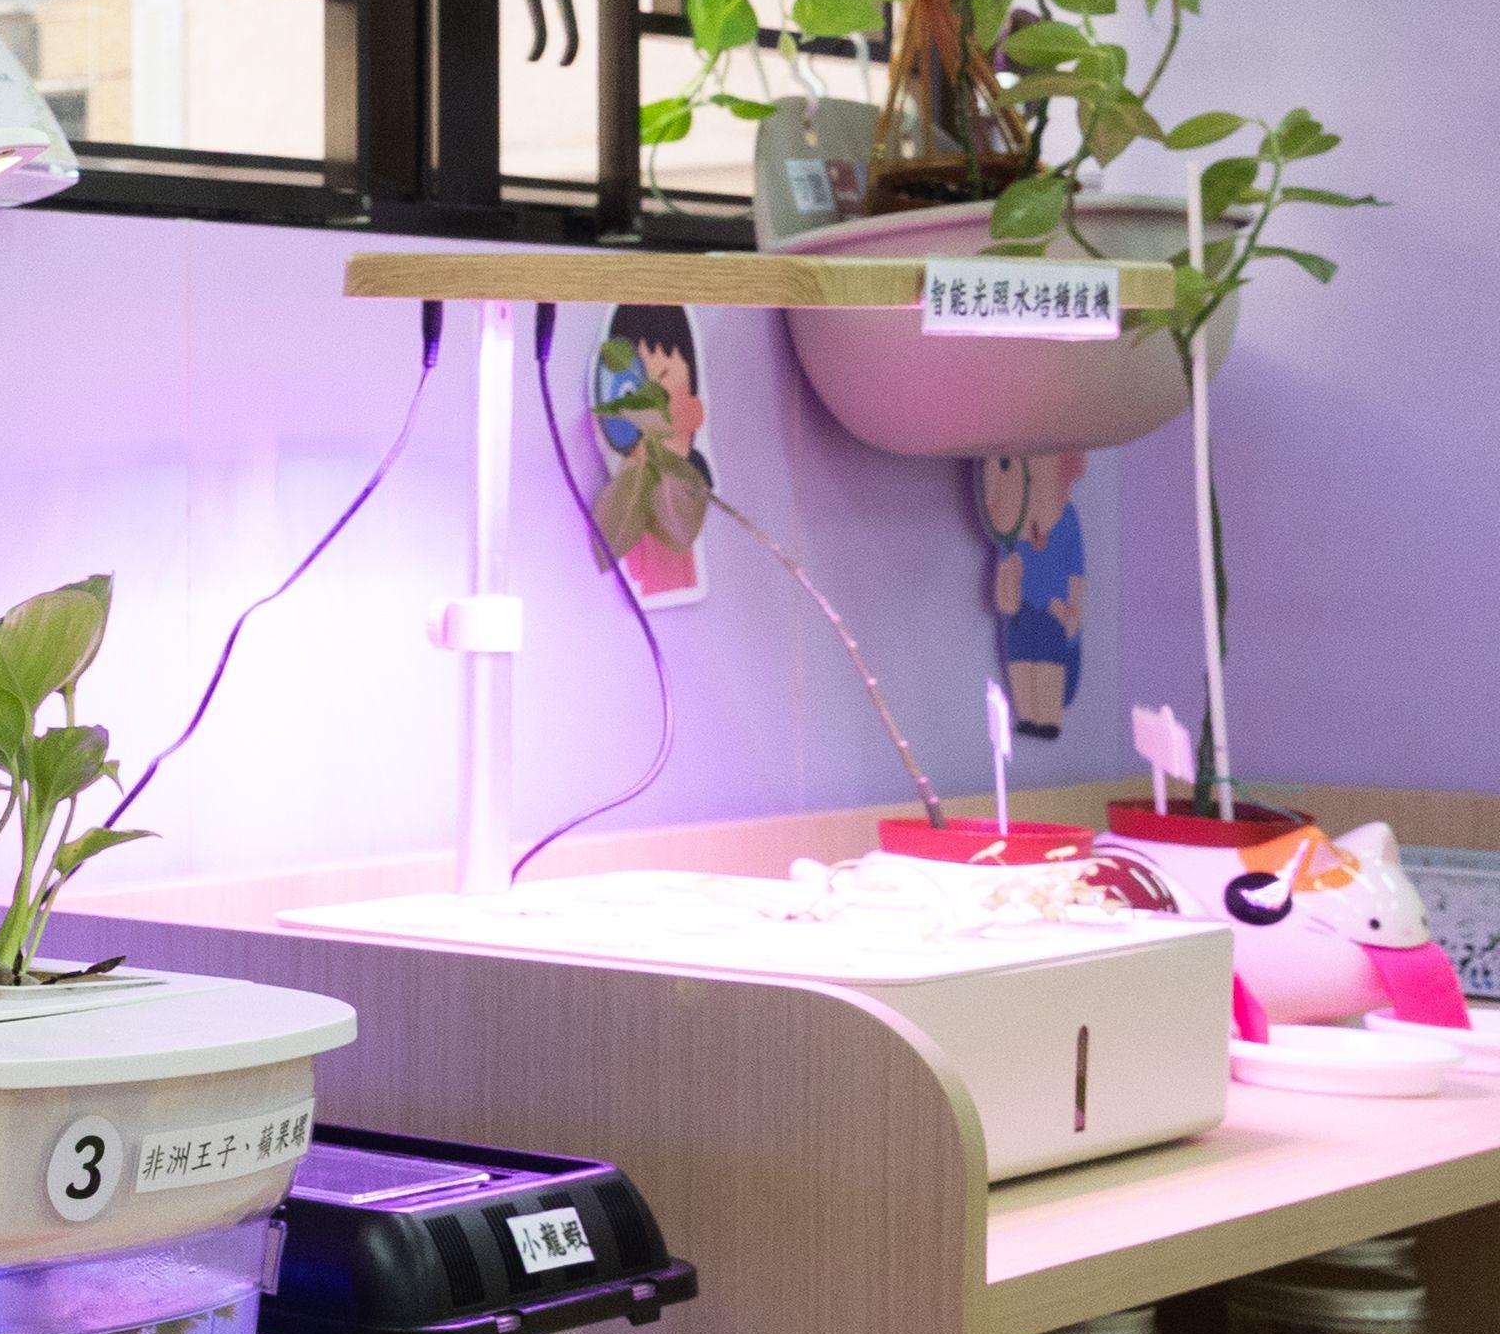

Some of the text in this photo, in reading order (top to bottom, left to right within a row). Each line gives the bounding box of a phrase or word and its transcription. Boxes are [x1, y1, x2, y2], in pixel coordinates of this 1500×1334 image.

[930, 273, 1111, 321] 智能光照水培種植機
[65, 1133, 106, 1201] 3
[142, 1112, 309, 1181] 非洲王子、蘋果螺
[522, 1219, 589, 1262] 小龍蝦
